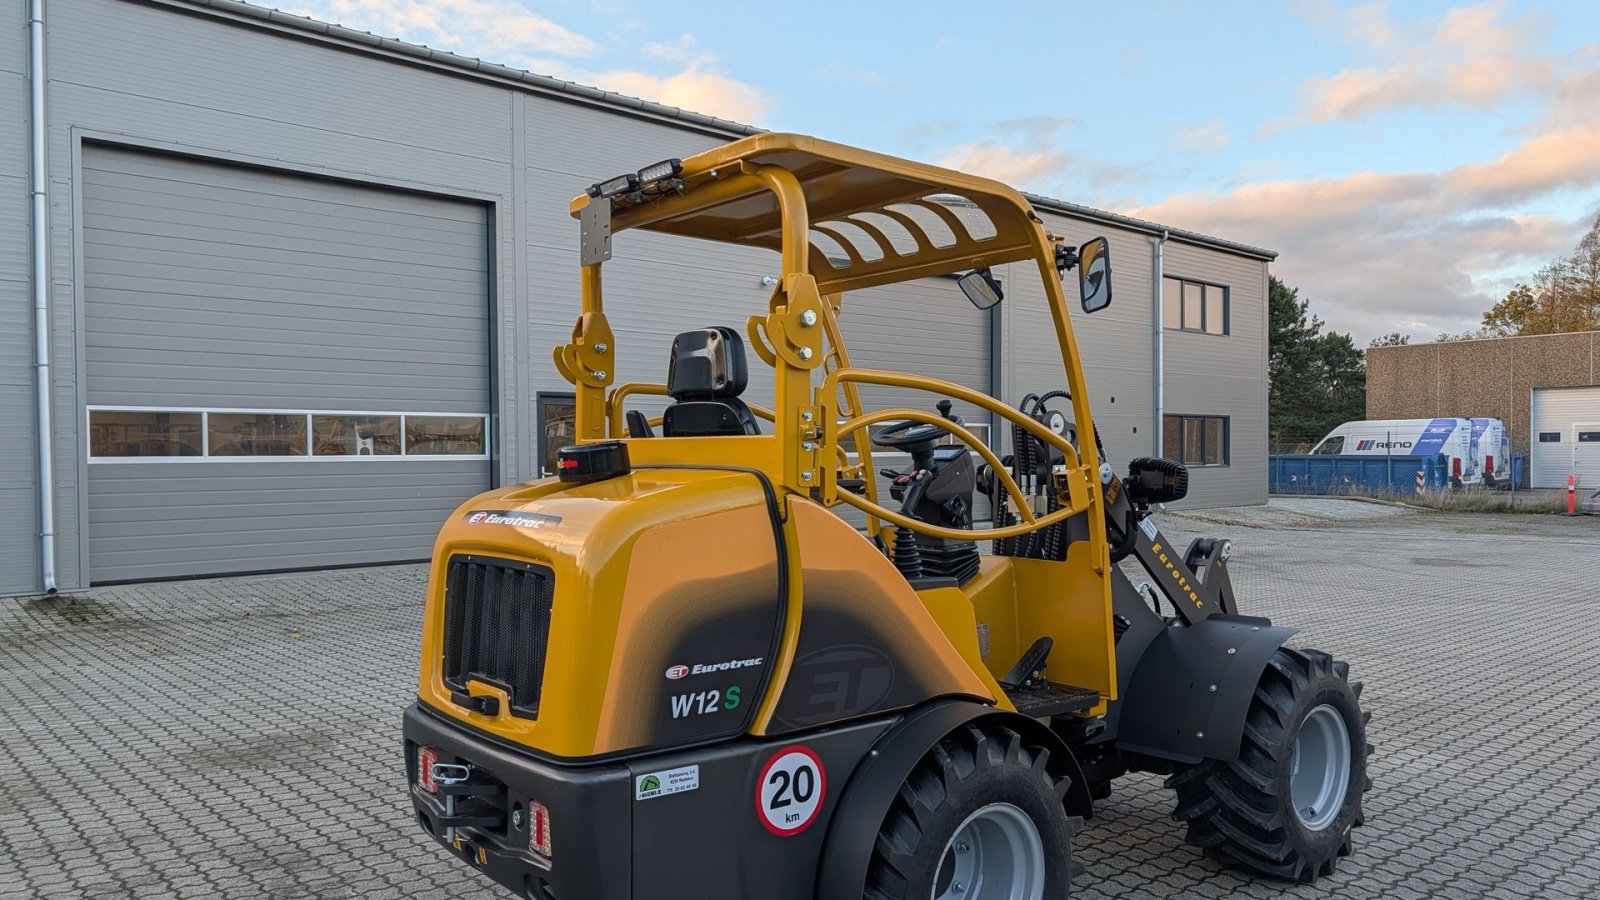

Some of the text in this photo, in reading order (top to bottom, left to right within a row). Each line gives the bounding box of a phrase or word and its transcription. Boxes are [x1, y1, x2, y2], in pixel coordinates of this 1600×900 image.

[1376, 441, 1412, 449] RENO
[484, 513, 545, 529] Eurotrac
[1152, 543, 1203, 609] Eurotrac
[691, 657, 763, 675] Eurotrac
[671, 686, 740, 718] W12 S
[769, 765, 814, 810] 20
[785, 813, 800, 823] km
